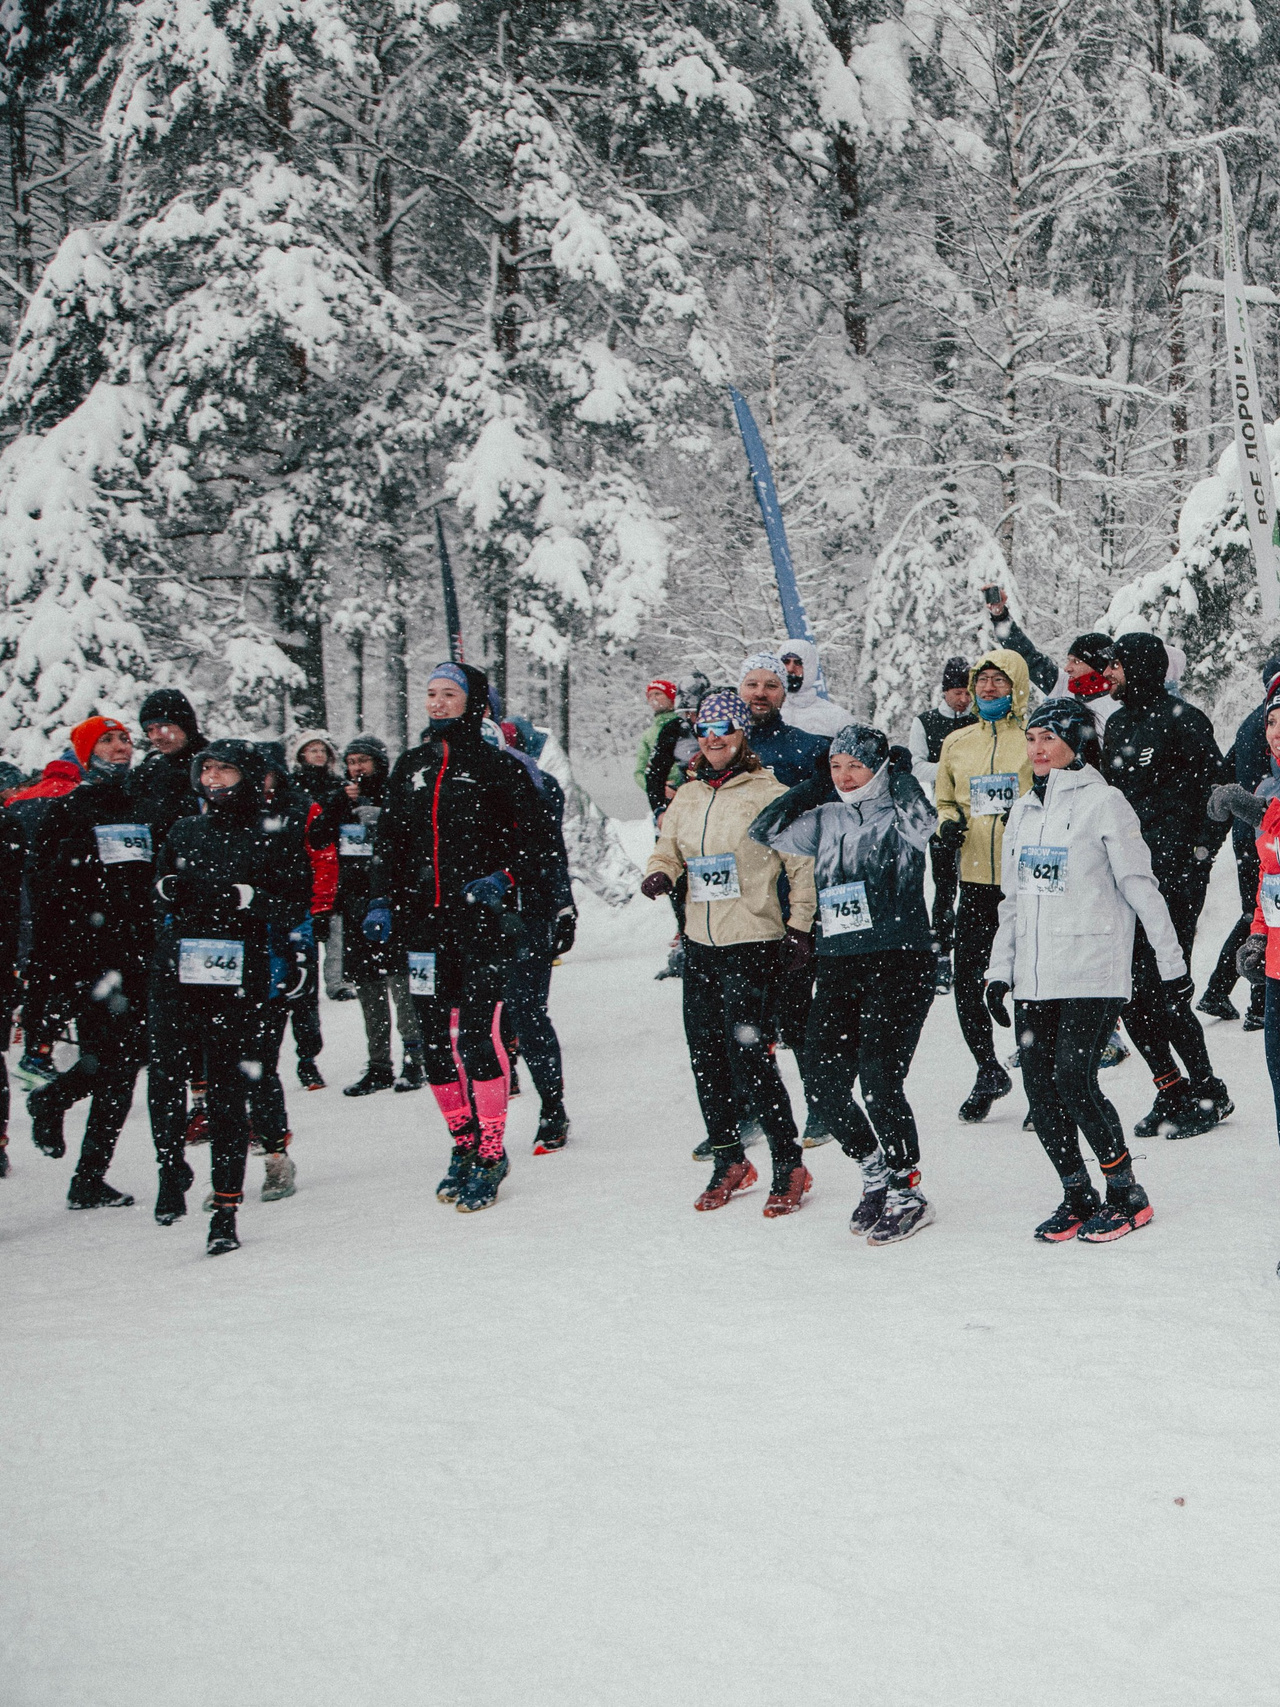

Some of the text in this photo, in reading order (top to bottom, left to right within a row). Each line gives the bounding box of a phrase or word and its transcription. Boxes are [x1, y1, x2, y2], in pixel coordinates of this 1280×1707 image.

[987, 787, 1014, 801] 910
[123, 836, 147, 849] 851
[702, 870, 730, 887] 927
[1033, 863, 1059, 880] 621
[832, 899, 862, 919] 763
[203, 955, 237, 970] 646
